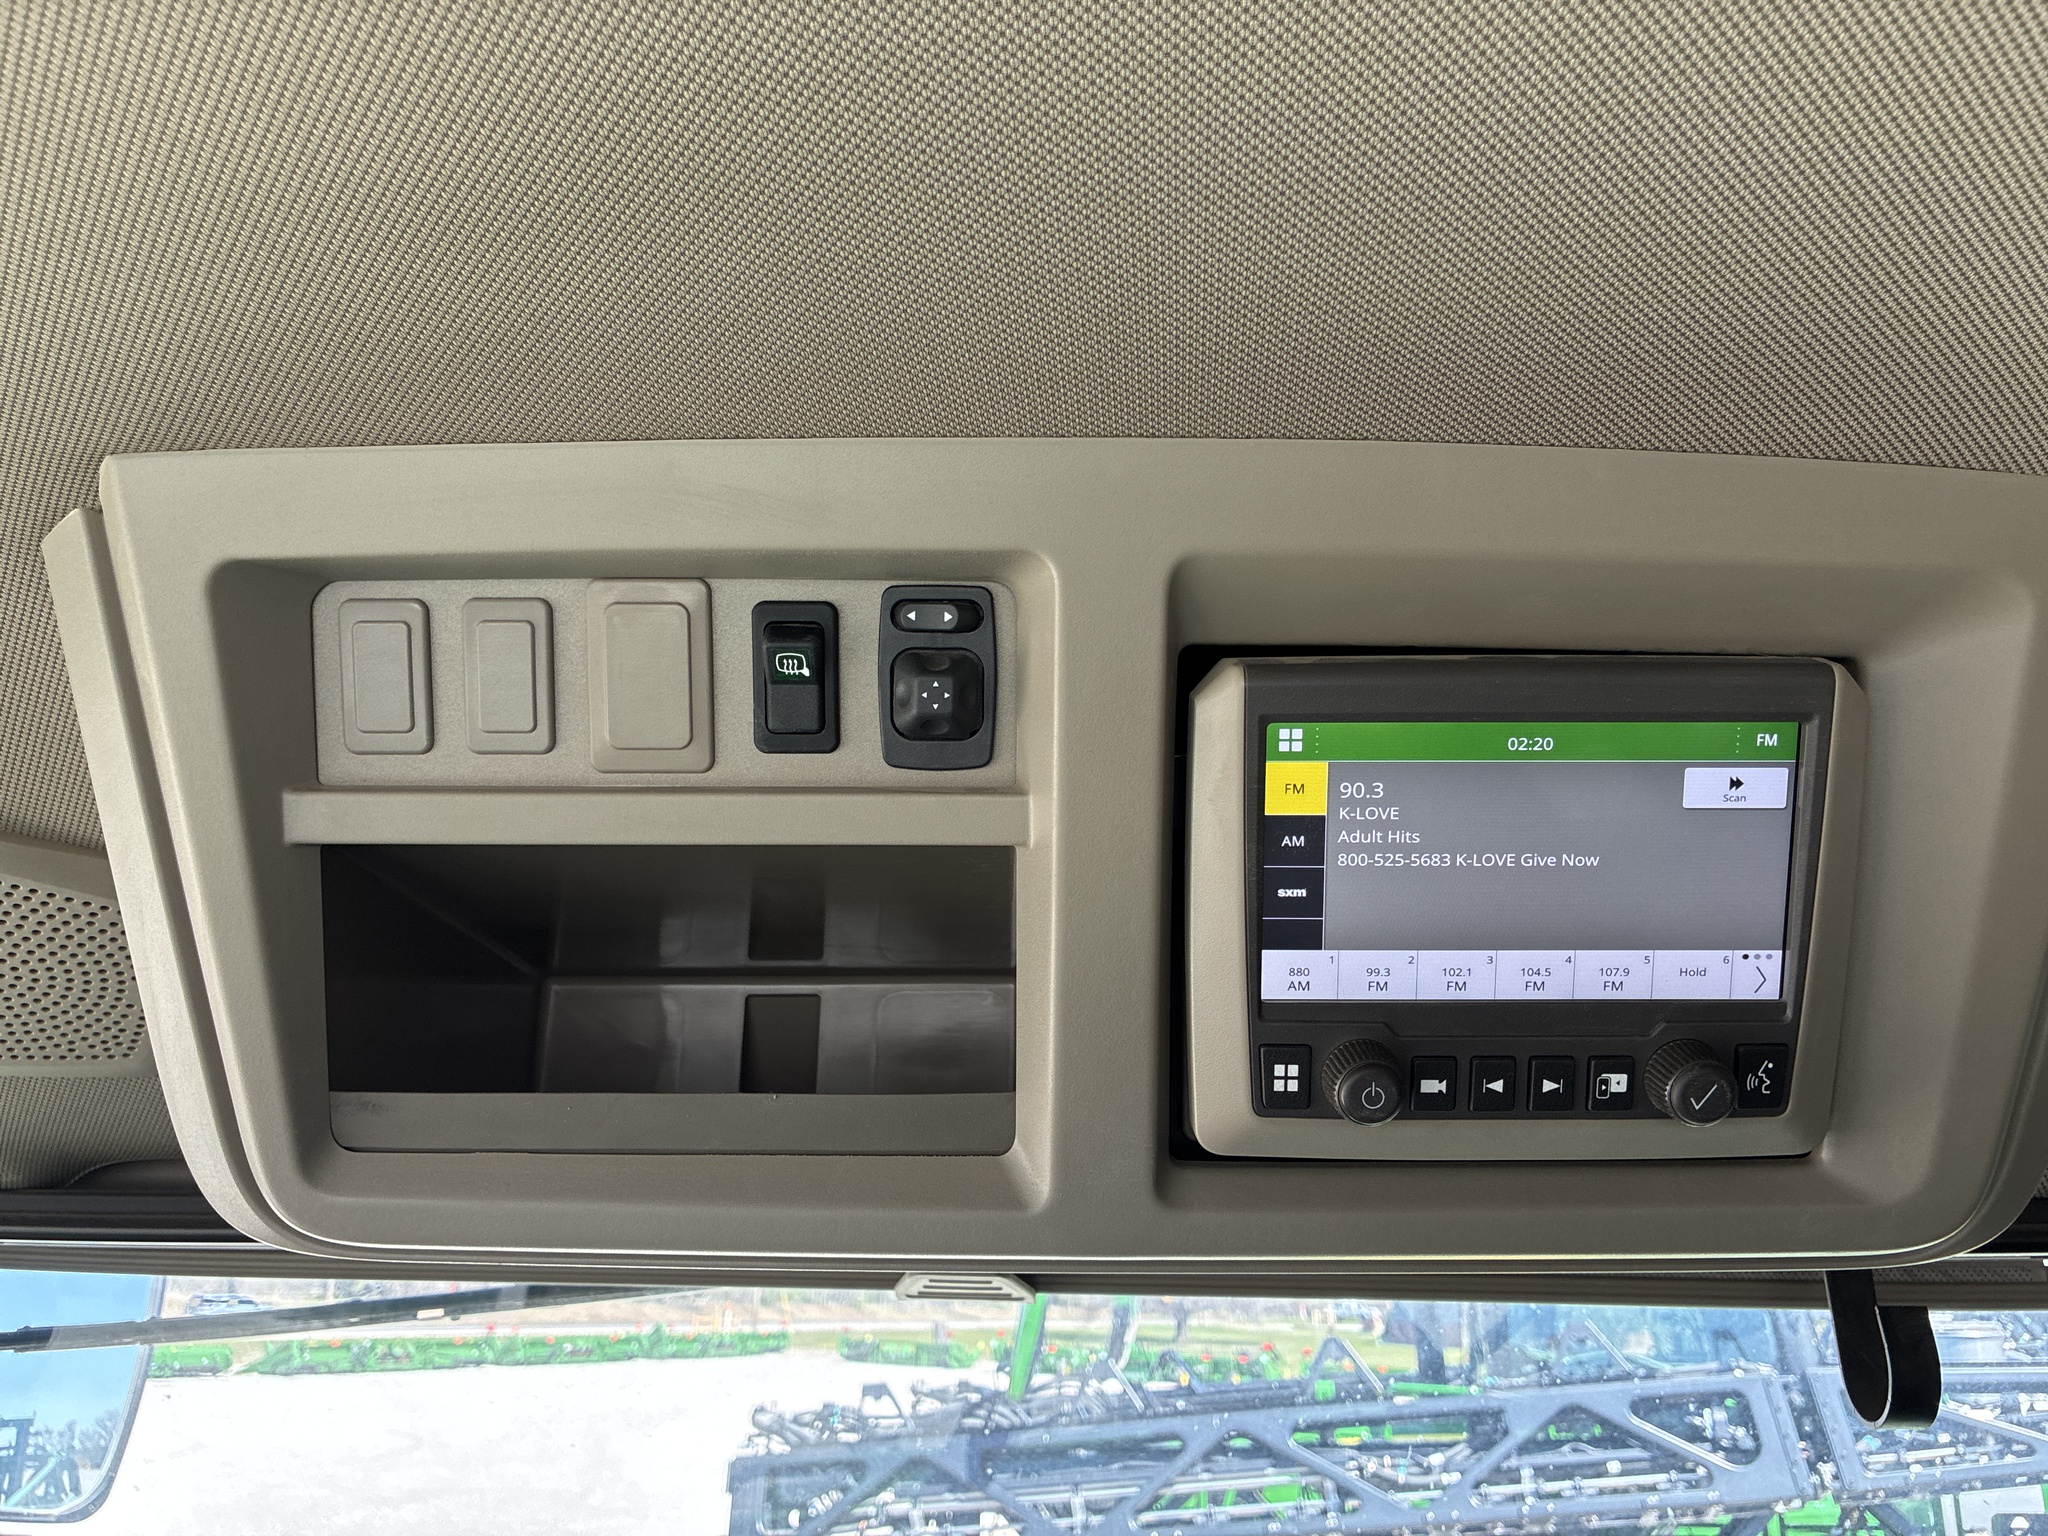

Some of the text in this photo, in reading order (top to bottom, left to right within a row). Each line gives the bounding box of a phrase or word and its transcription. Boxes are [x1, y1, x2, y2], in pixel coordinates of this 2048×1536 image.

[1507, 737, 1554, 751] 02:20
[1756, 733, 1778, 747] FM
[1284, 783, 1305, 795] FM
[1339, 782, 1384, 799] 90.3
[1722, 793, 1747, 803] Scan
[1339, 806, 1400, 820] K-LOVE
[1281, 835, 1305, 847] AM
[1337, 829, 1421, 844] Adult Hits
[1337, 853, 1600, 867] 800-525-5683 K-LOVE Give Now
[1277, 888, 1307, 898] sxm
[1288, 967, 1311, 977] 880
[1365, 967, 1391, 977] 99.3
[1442, 967, 1472, 977] 102.1
[1520, 967, 1552, 977] 104.5
[1599, 967, 1630, 977] 107.9
[1679, 967, 1707, 977] Hold
[1287, 980, 1310, 992] AM
[1368, 980, 1388, 992] FM
[1446, 980, 1467, 992] FM
[1525, 980, 1545, 992] FM
[1603, 980, 1624, 992] FM
